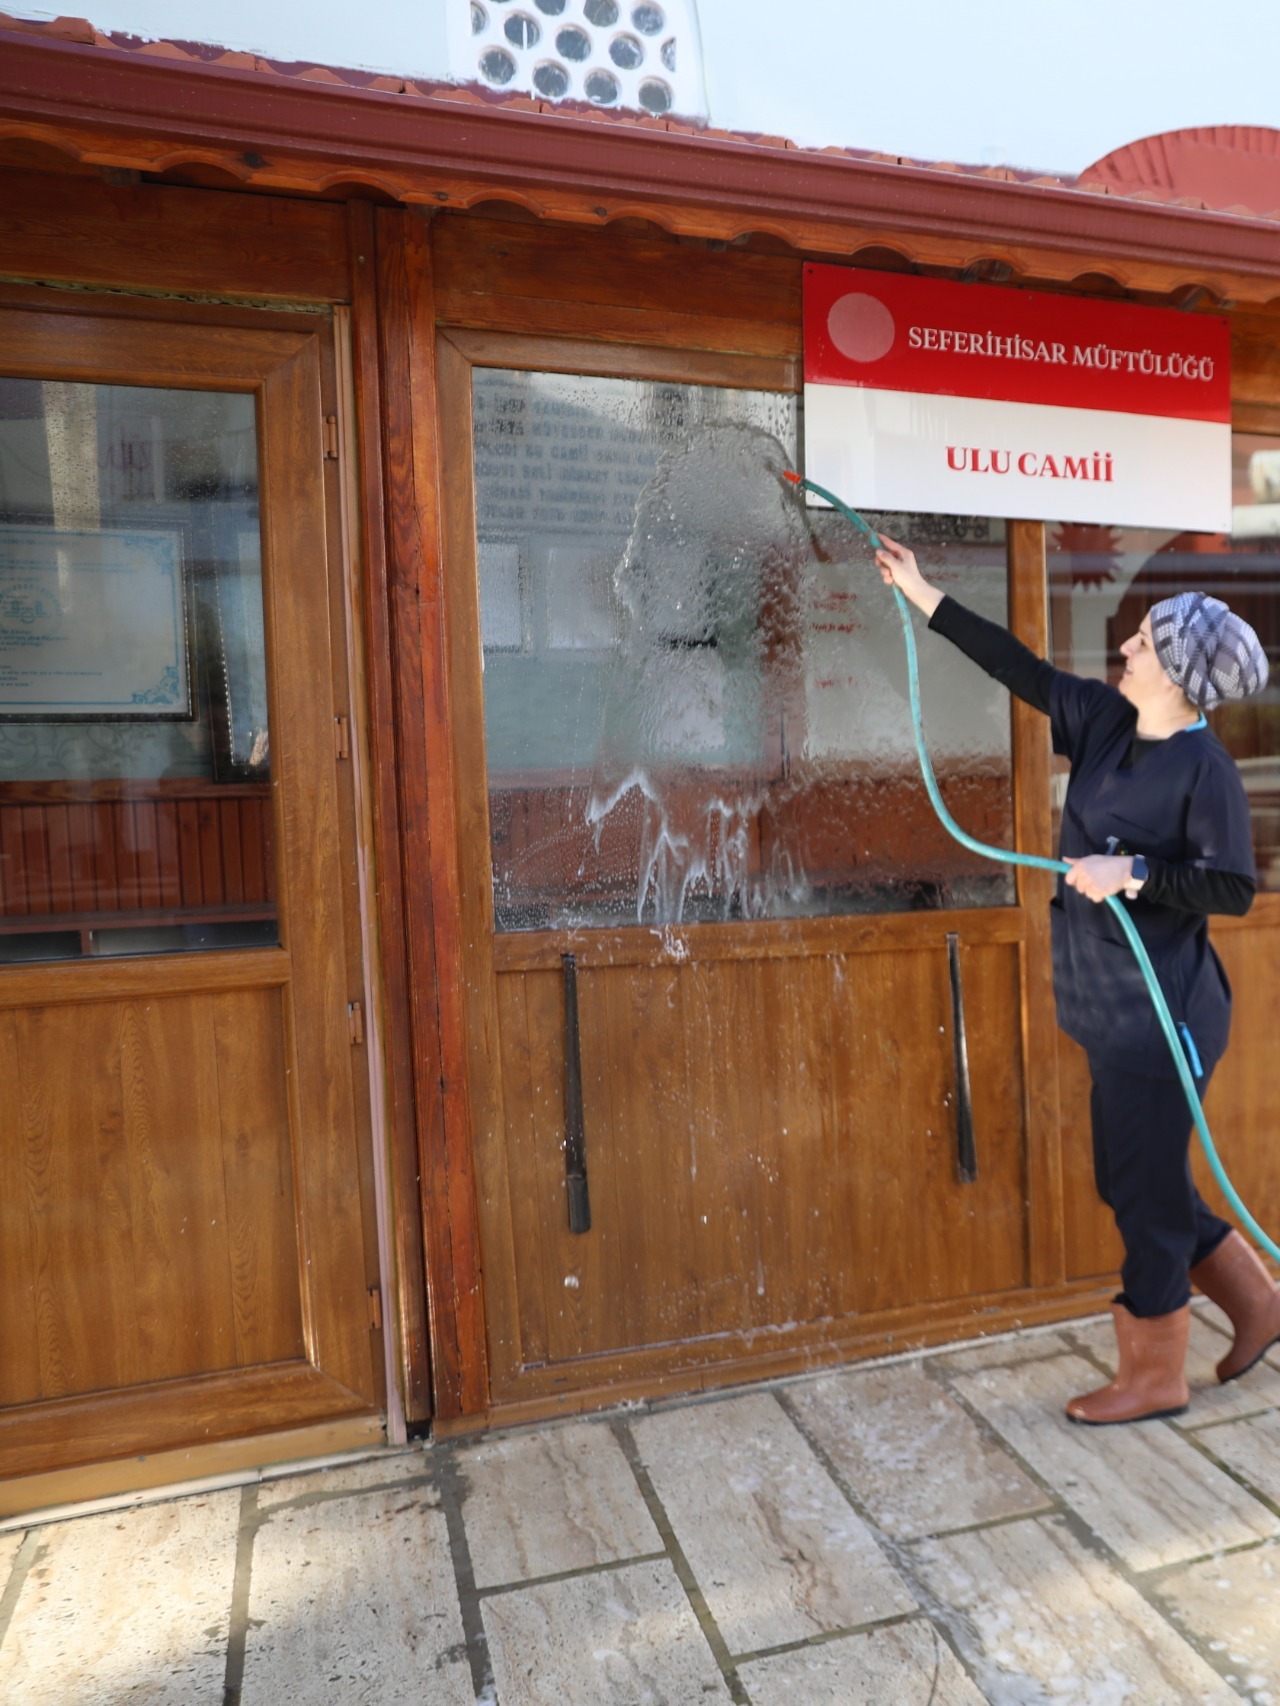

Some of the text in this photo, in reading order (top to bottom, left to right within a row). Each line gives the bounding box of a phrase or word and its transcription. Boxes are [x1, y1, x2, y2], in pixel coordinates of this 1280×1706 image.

[908, 326, 1214, 382] SEFERİHİSAR MÜFTÜLÜĞÜ
[946, 446, 1114, 482] ULU CAMİİ
